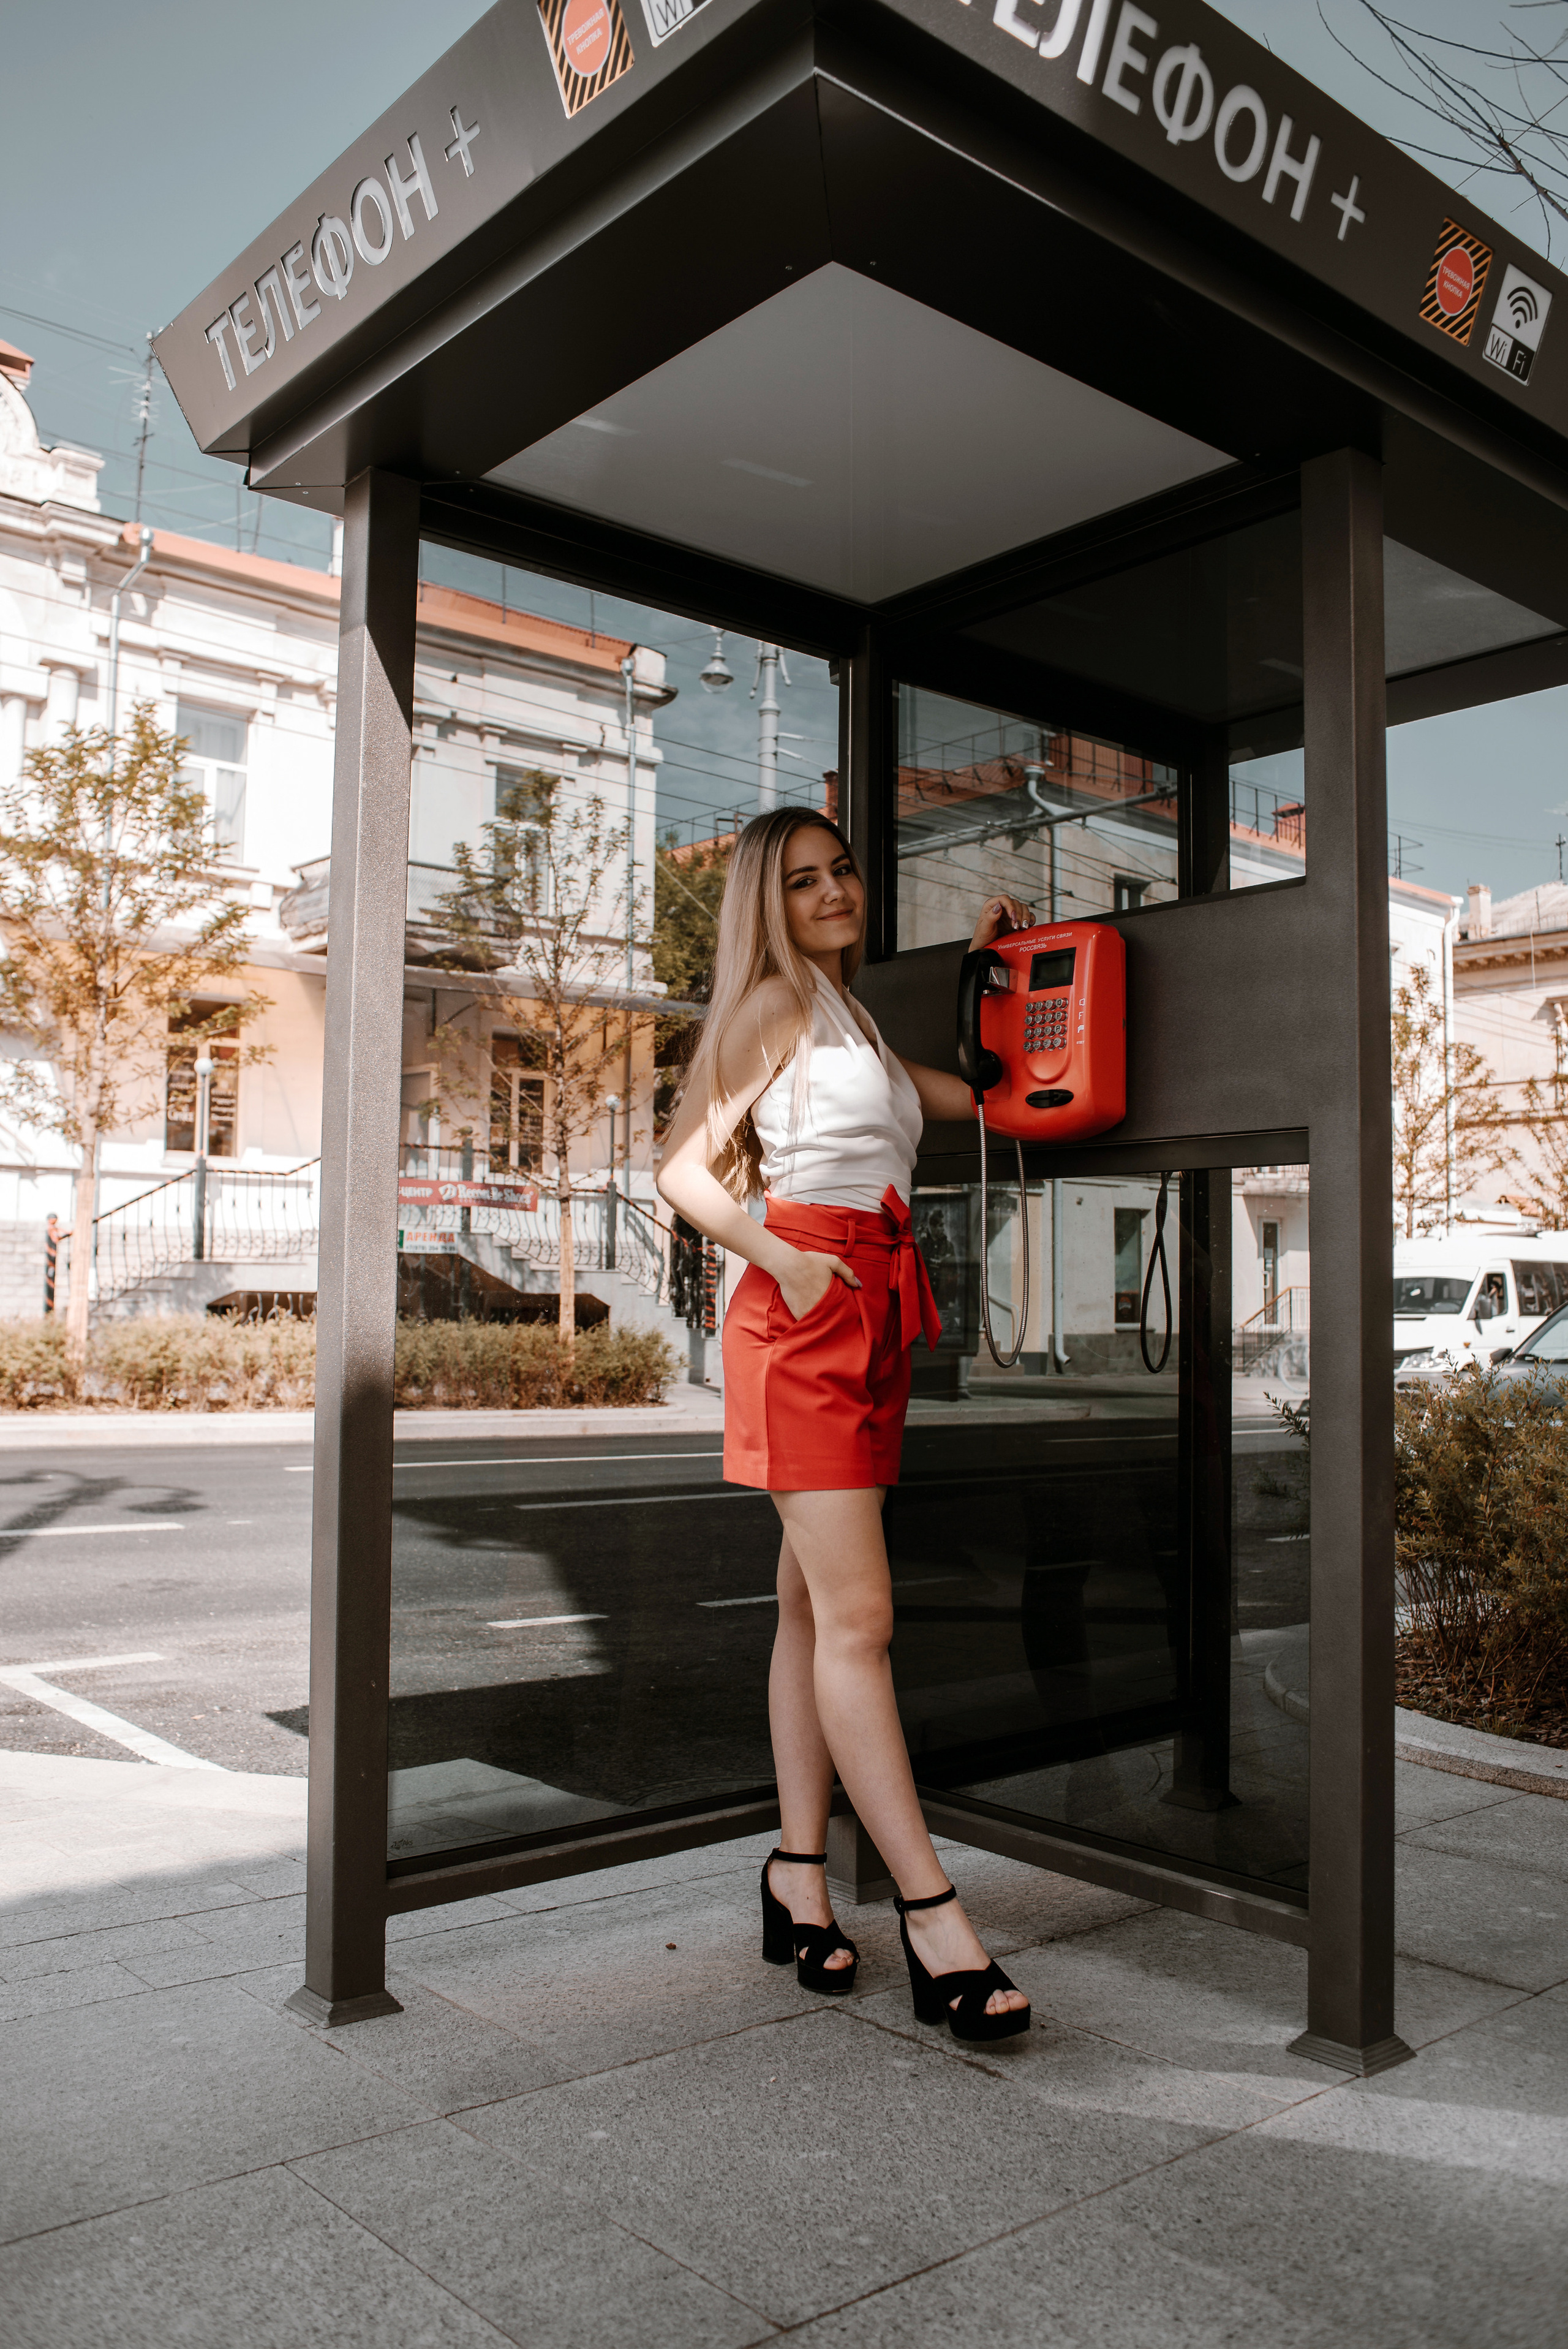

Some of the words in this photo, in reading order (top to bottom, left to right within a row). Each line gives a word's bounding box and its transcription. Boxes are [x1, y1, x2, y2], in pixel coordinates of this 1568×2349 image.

[567, 7, 605, 46] ТРЕВОЖНАЯ
[576, 28, 603, 55] КНОПКА
[957, 0, 1322, 223] ЛЕФОН
[1330, 174, 1366, 241] +
[204, 131, 439, 392] ТЕЛЕФОН
[443, 105, 481, 178] +
[1442, 266, 1471, 290] ТРЕВОЖНАЯ
[1443, 280, 1463, 299] КНОПКА
[1019, 943, 1047, 953] РОССВЯЗЬ
[406, 1231, 455, 1243] АРЕНДА
